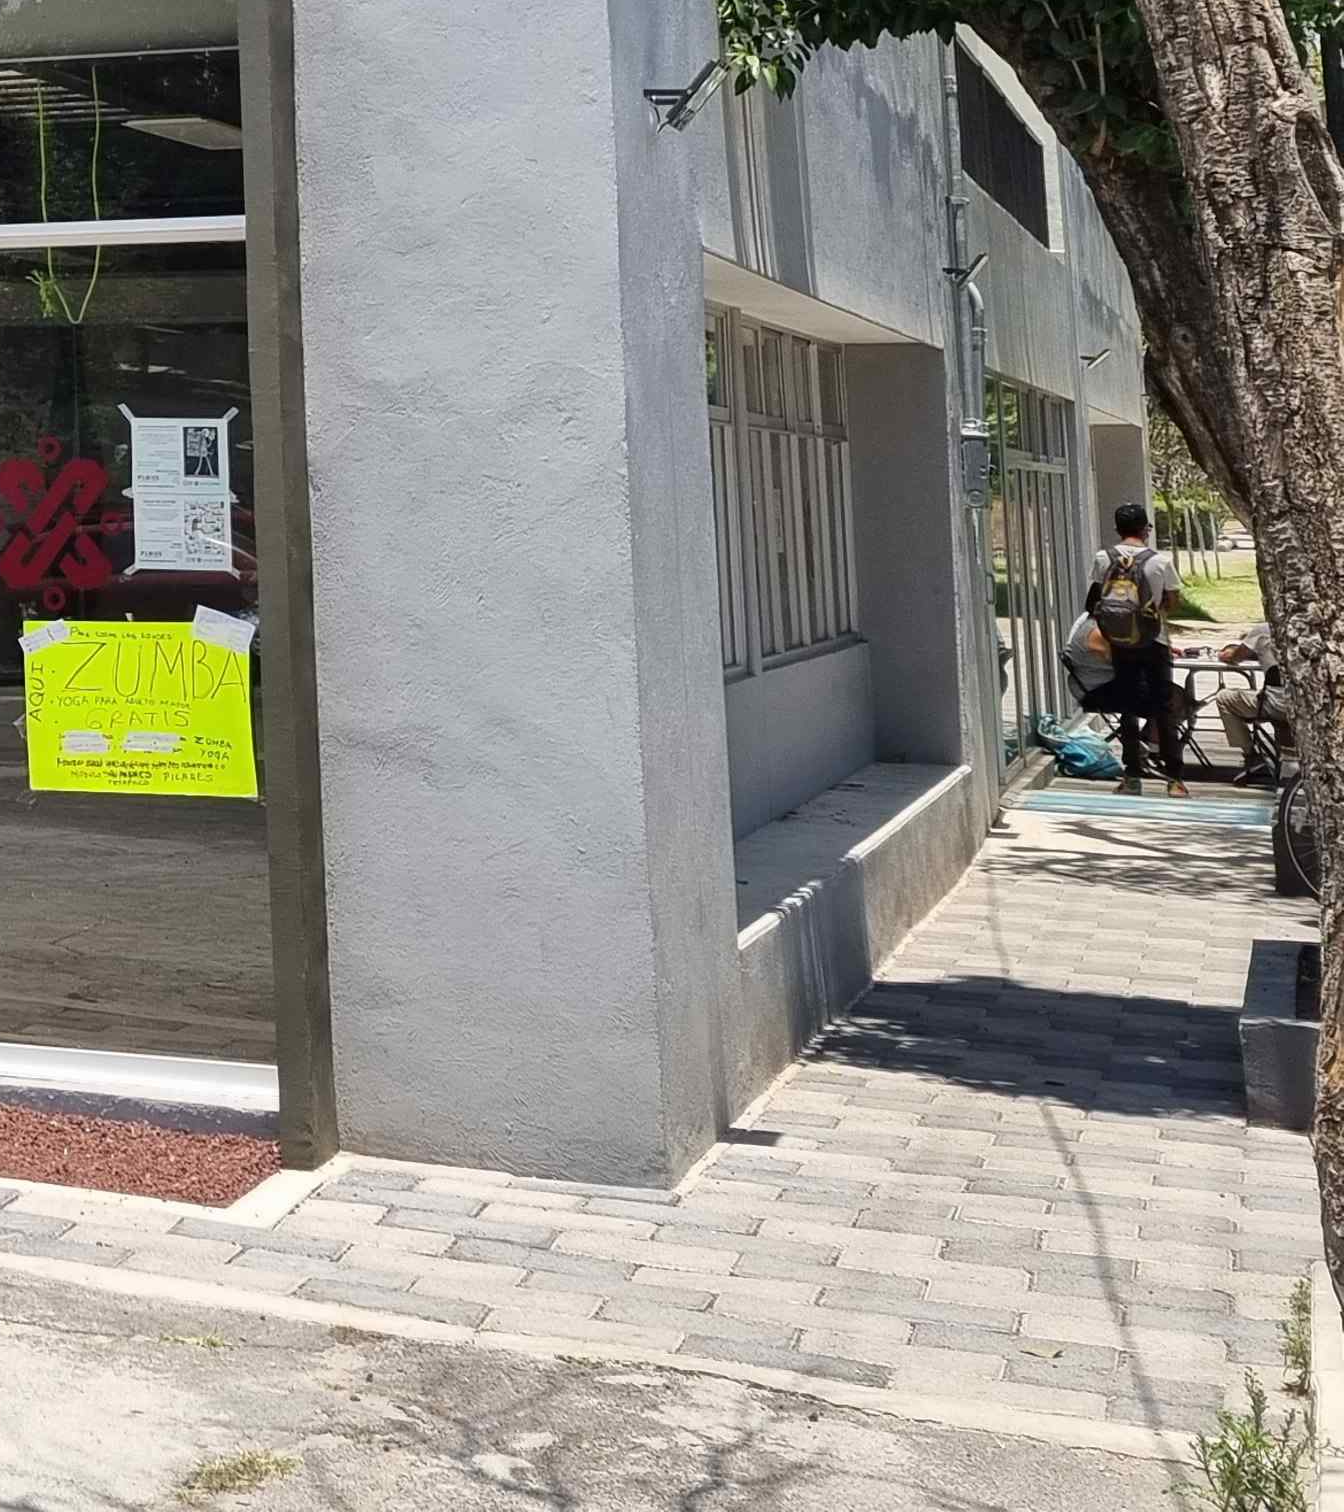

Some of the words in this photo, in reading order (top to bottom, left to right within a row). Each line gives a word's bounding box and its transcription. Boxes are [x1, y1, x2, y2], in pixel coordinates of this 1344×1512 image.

[61, 639, 247, 703] ZUMBA
[56, 695, 89, 707] YOGA
[86, 708, 190, 729] GRATIS
